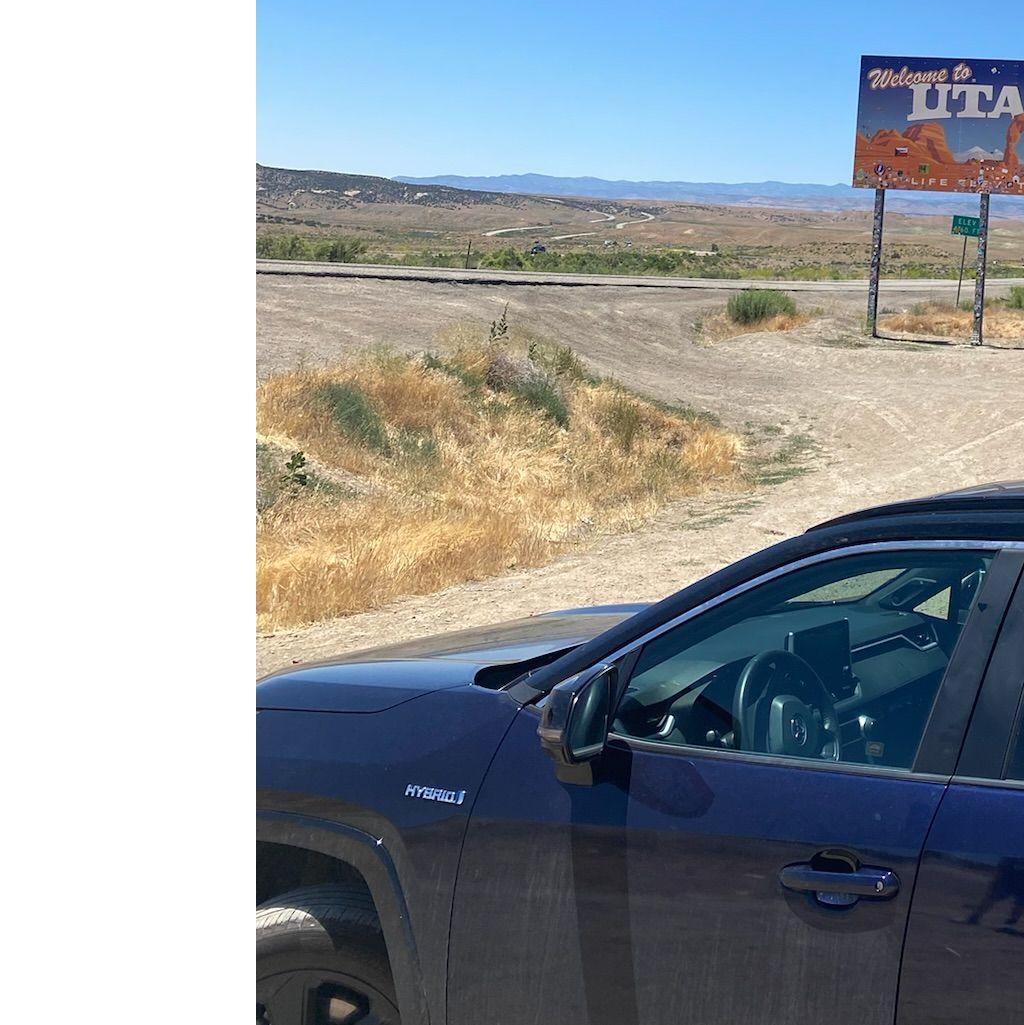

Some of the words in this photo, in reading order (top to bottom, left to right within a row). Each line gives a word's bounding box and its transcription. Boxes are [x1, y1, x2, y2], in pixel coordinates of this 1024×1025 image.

[867, 66, 948, 89] Welcome
[952, 62, 972, 81] to
[911, 177, 948, 186] LIFE
[405, 784, 456, 804] HYBRID
